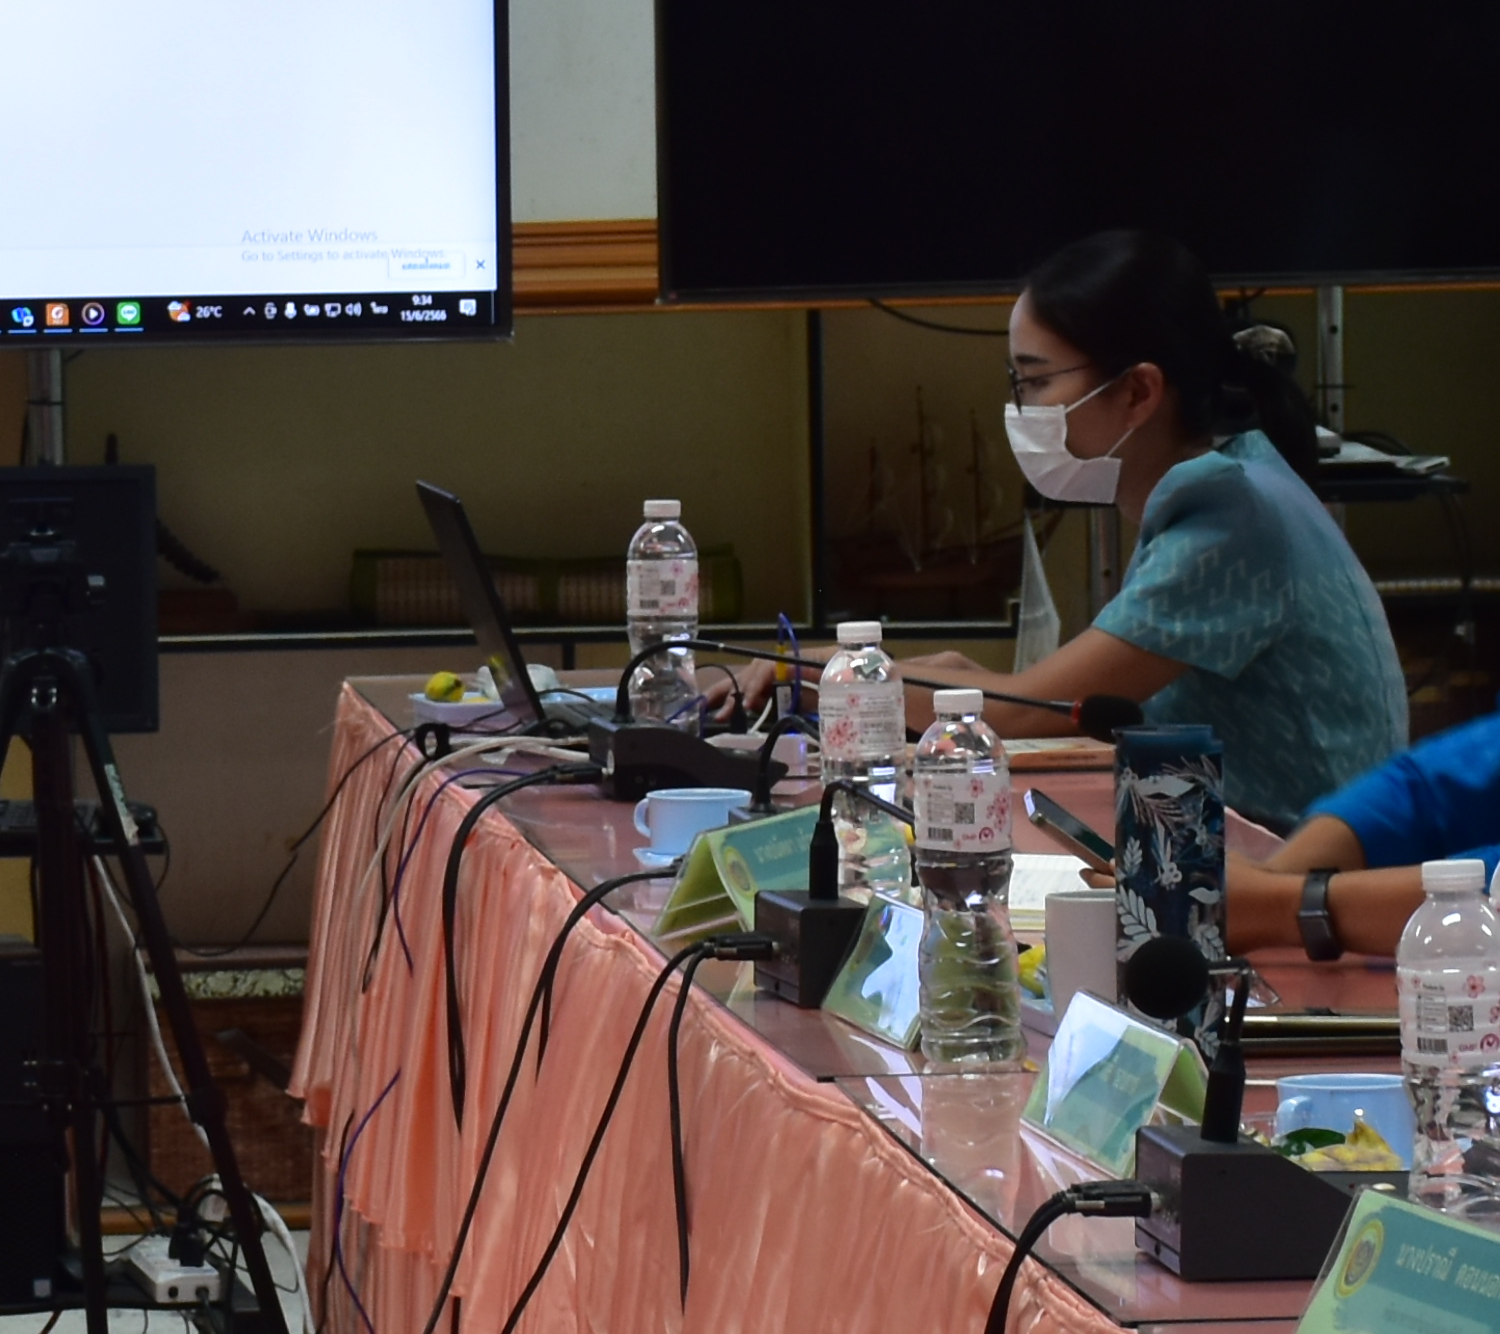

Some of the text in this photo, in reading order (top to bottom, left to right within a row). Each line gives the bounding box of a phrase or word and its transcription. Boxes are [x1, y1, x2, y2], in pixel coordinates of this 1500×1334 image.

[241, 228, 378, 243] Activate Windows
[241, 250, 259, 261] Go
[262, 251, 274, 260] to
[278, 250, 323, 263] Settings
[327, 250, 339, 260] to
[342, 249, 388, 260] activate
[411, 294, 433, 306] 9:34
[195, 305, 223, 318] 26°C
